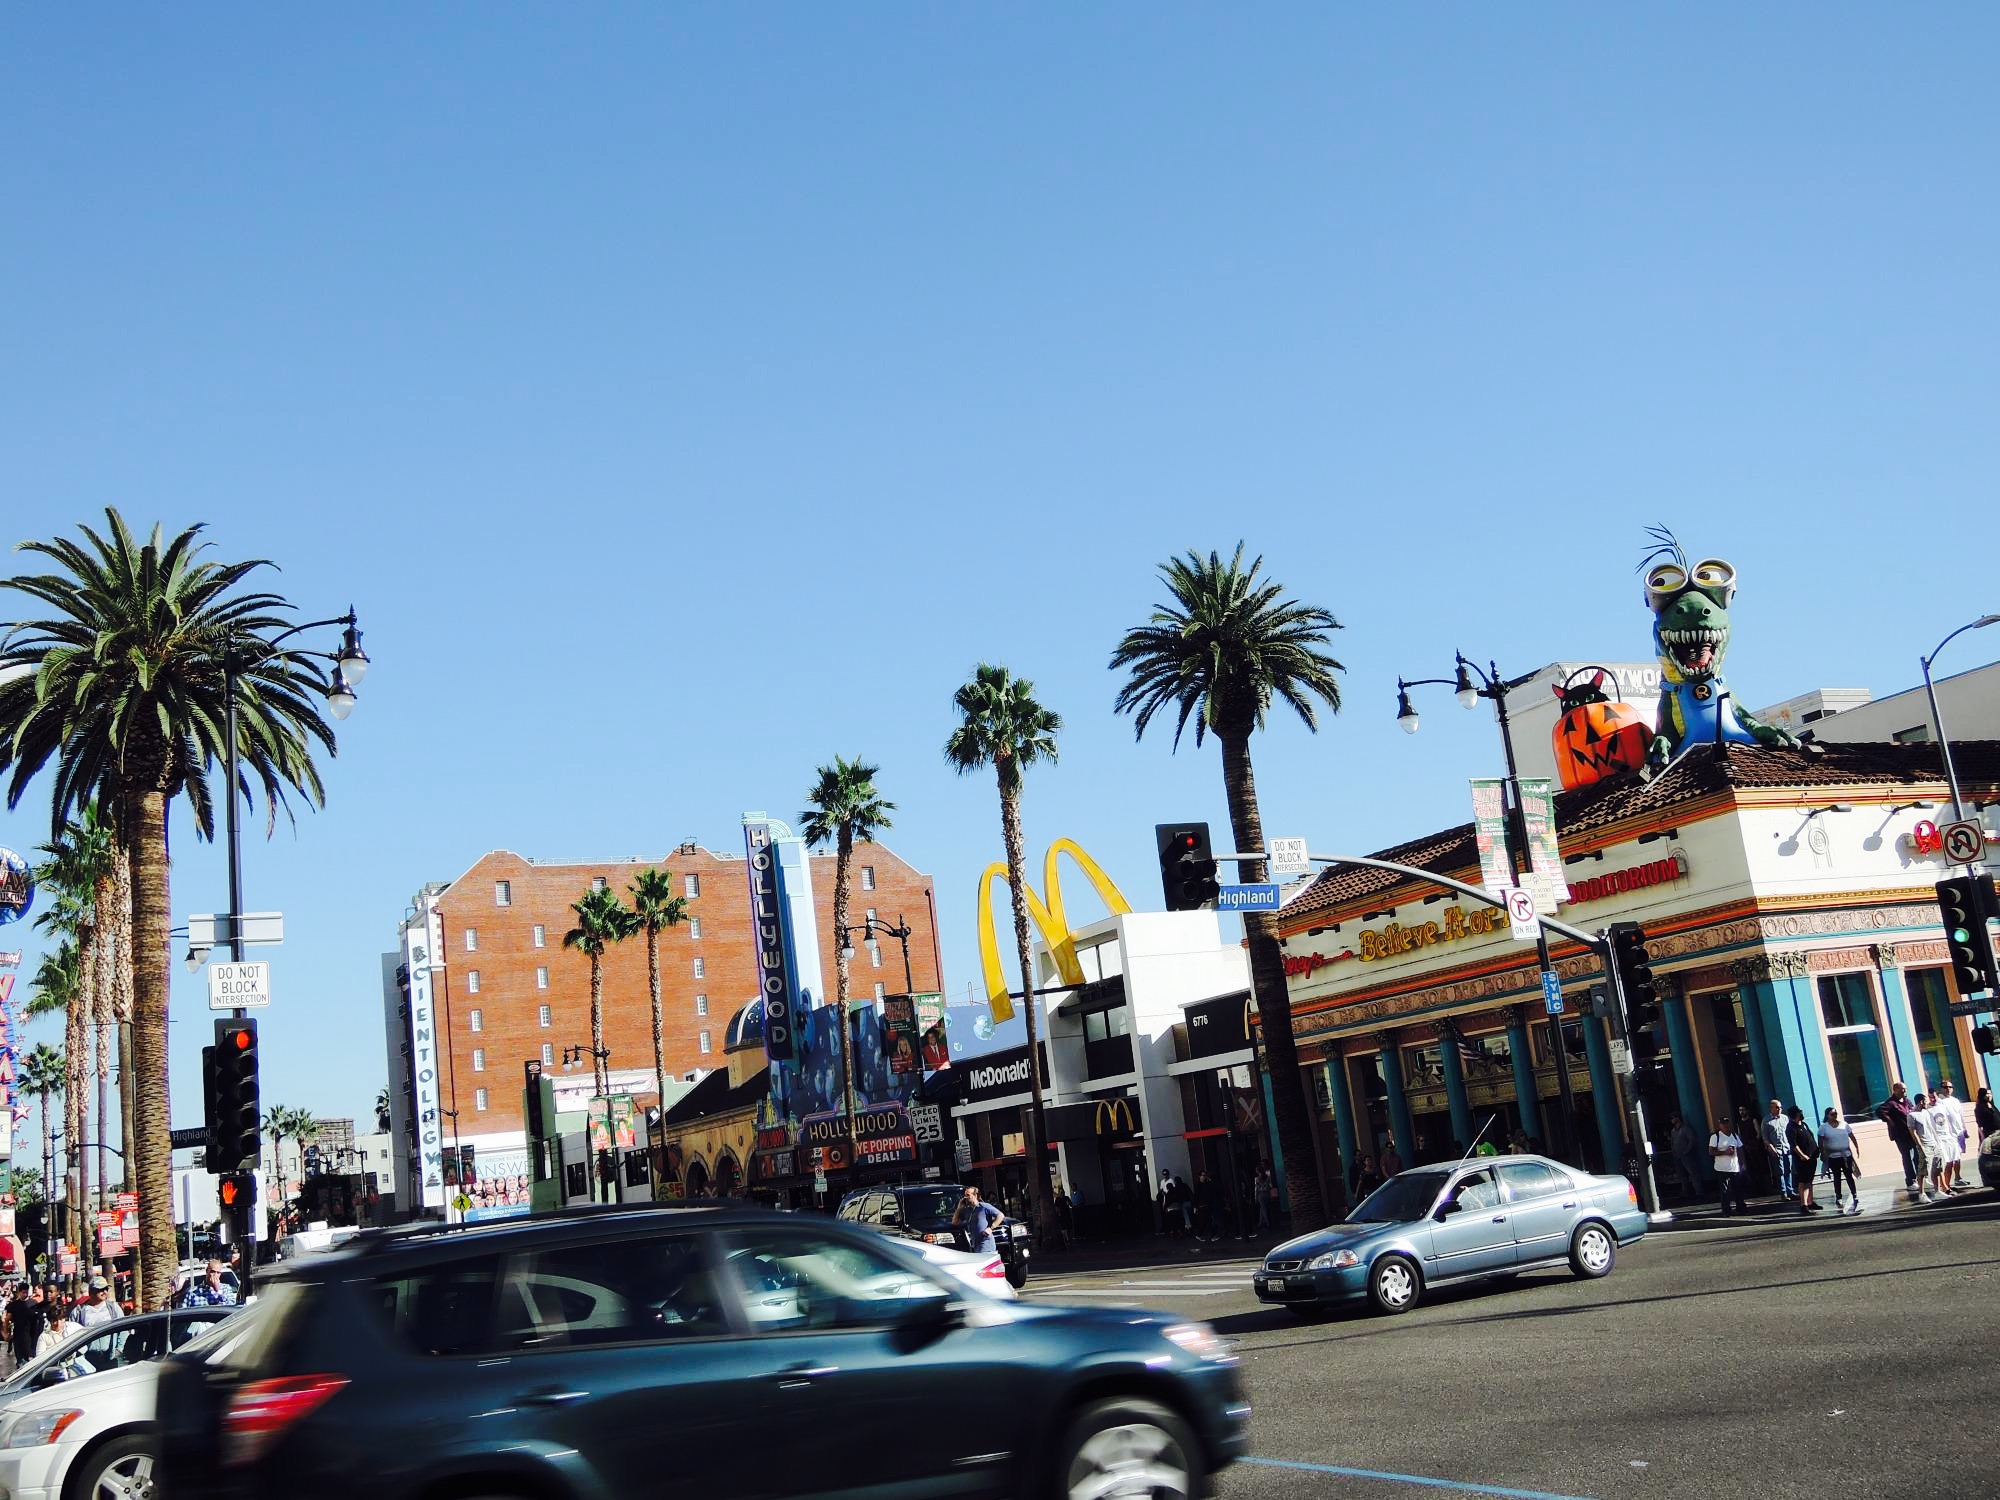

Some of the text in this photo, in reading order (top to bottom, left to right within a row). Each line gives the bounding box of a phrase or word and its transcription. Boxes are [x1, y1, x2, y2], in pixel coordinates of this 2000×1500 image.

[1275, 840, 1302, 852] DO NOT
[1278, 852, 1302, 863] BLOCK
[1274, 862, 1309, 872] INTERSECTION
[1218, 889, 1274, 909] Highland
[1358, 920, 1440, 962] Believe
[1468, 906, 1499, 935] or
[1514, 924, 1538, 935] ON RED
[750, 829, 787, 1044] HOLLYWOOD
[218, 965, 261, 980] DO NOT
[221, 980, 258, 994] BLOCK
[213, 993, 267, 1005] INTERSECTION
[1192, 1014, 1209, 1027] 6776
[912, 1107, 938, 1118] SPEED
[916, 1116, 938, 1125] LIMIT
[172, 1127, 211, 1144] Highland
[916, 1124, 940, 1141] 25
[854, 1135, 912, 1156] YE POPPING
[867, 1151, 900, 1164] DEAL!
